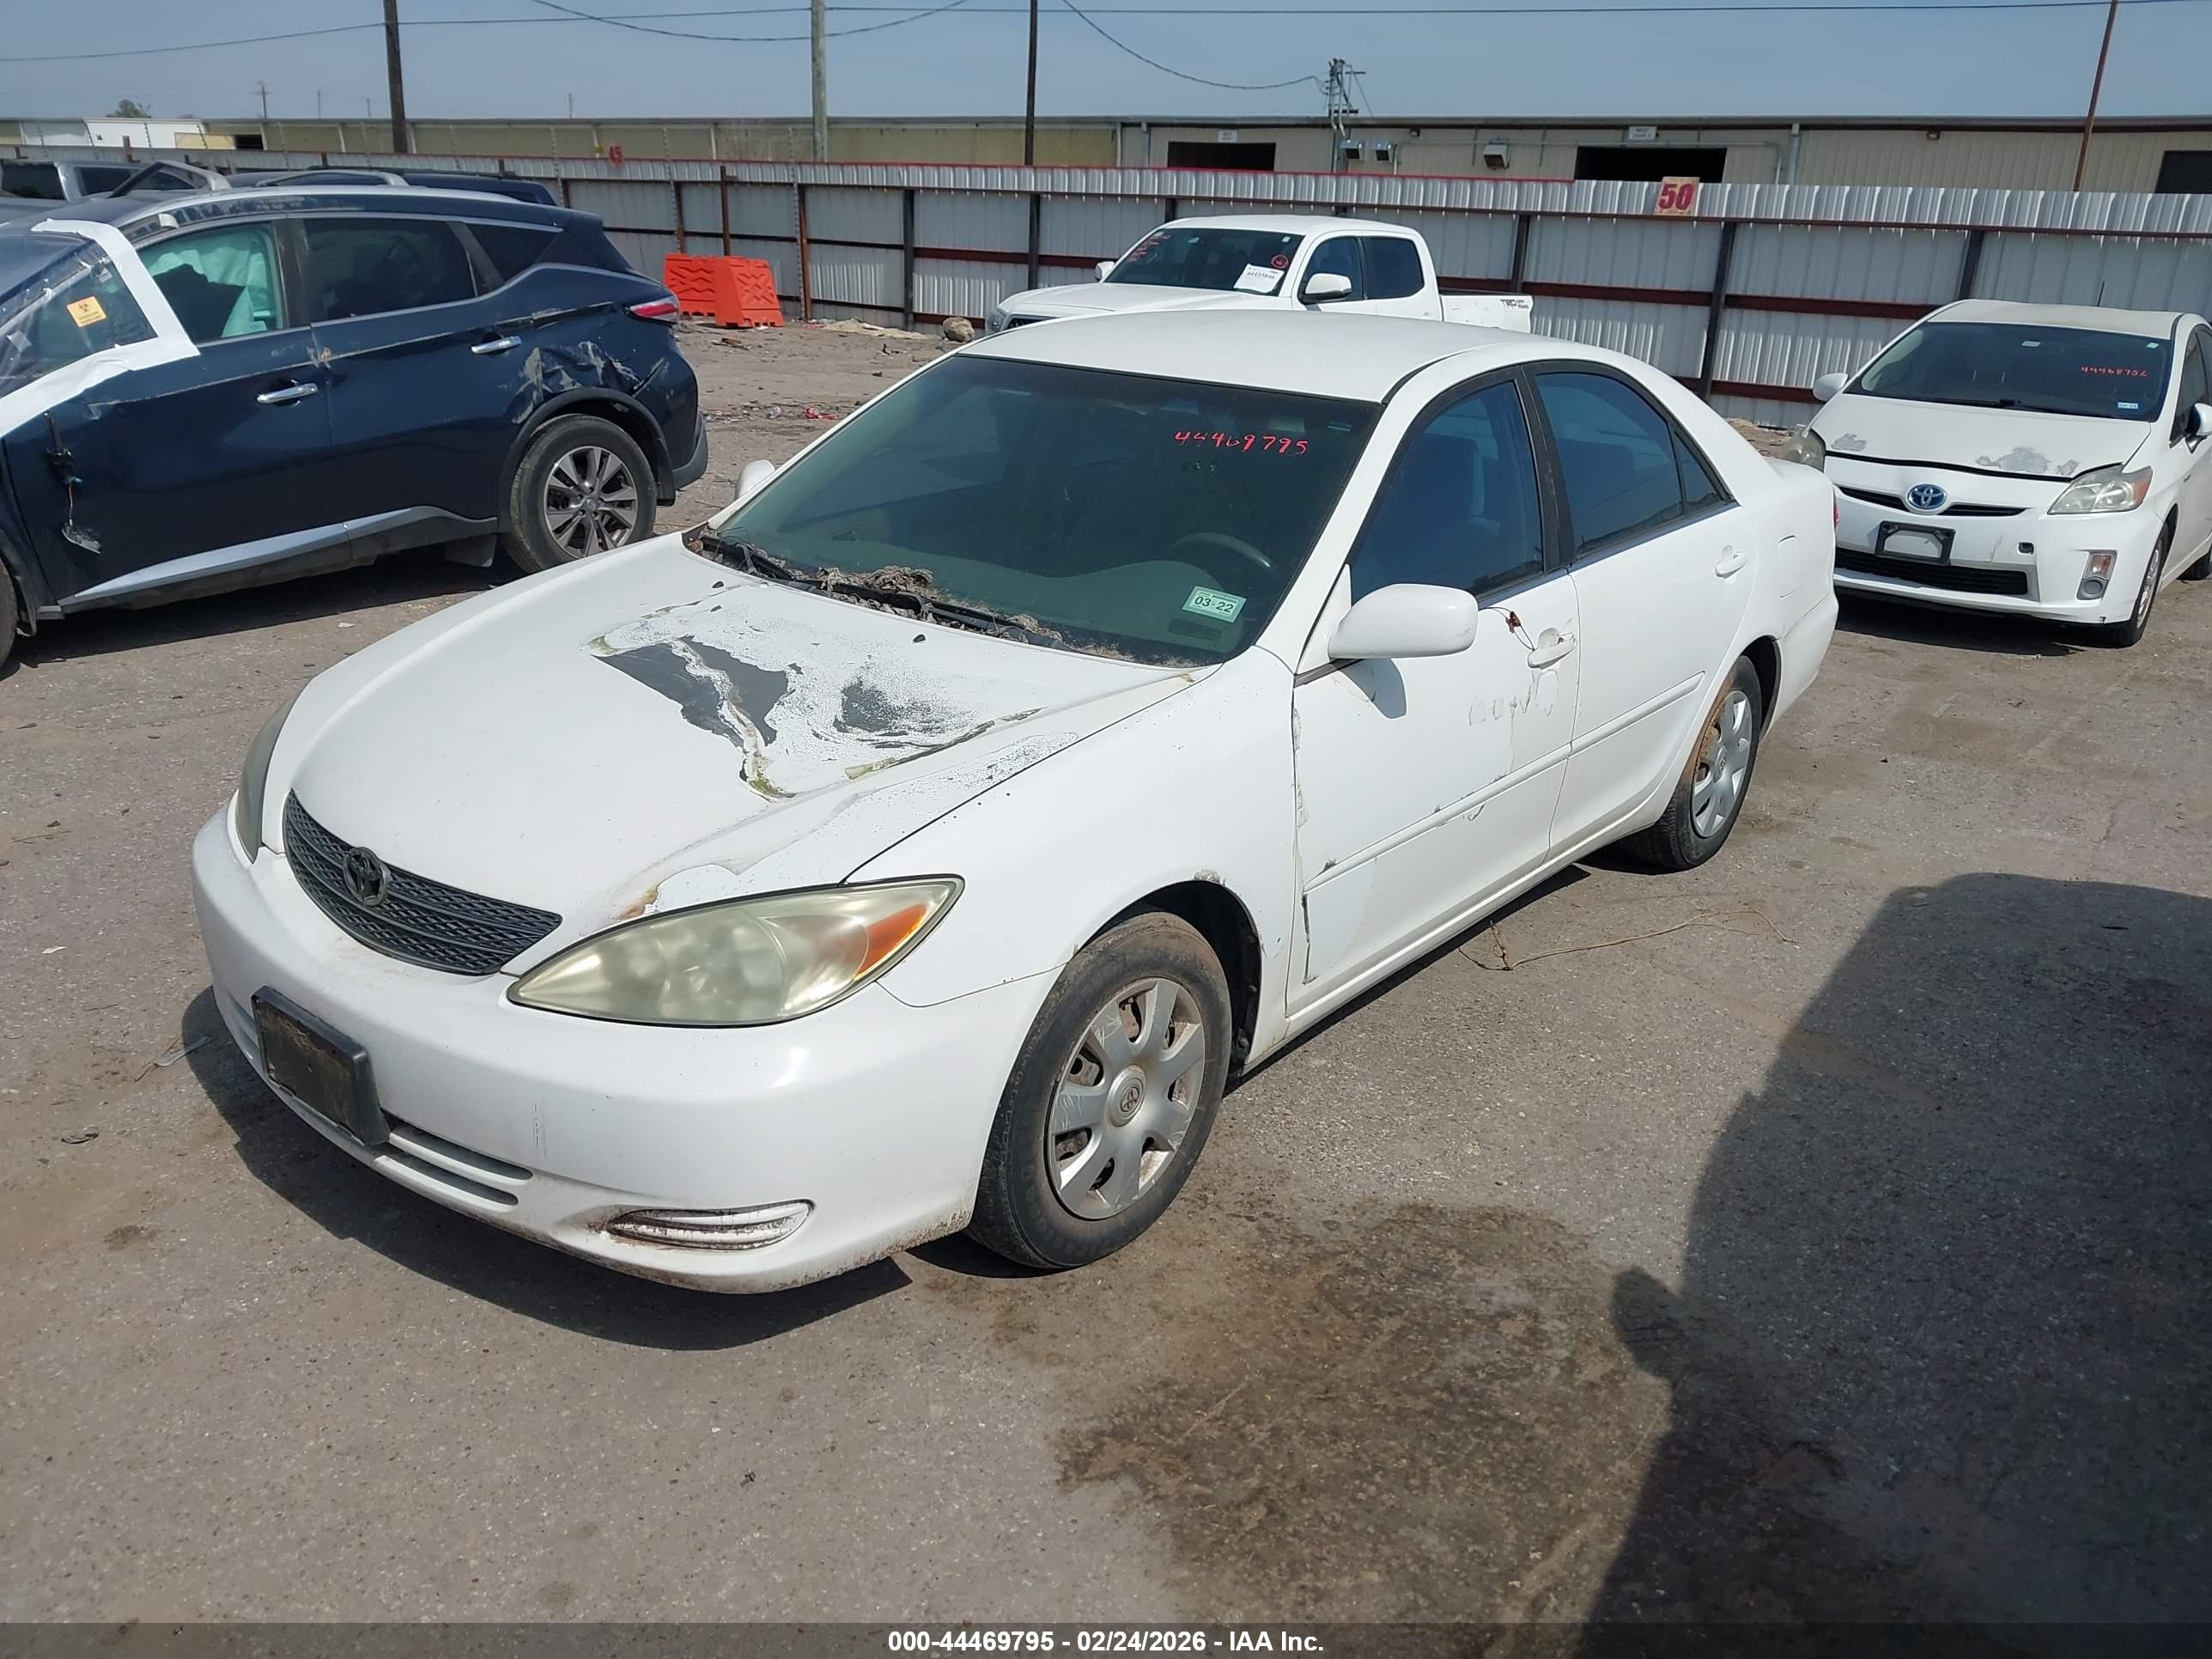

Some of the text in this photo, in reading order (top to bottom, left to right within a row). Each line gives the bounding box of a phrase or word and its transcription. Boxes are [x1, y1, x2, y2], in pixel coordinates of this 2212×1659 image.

[1658, 183, 1694, 210] 50
[1174, 431, 1310, 455] 44469795
[1194, 596, 1212, 608] 03
[1215, 601, 1235, 613] 22
